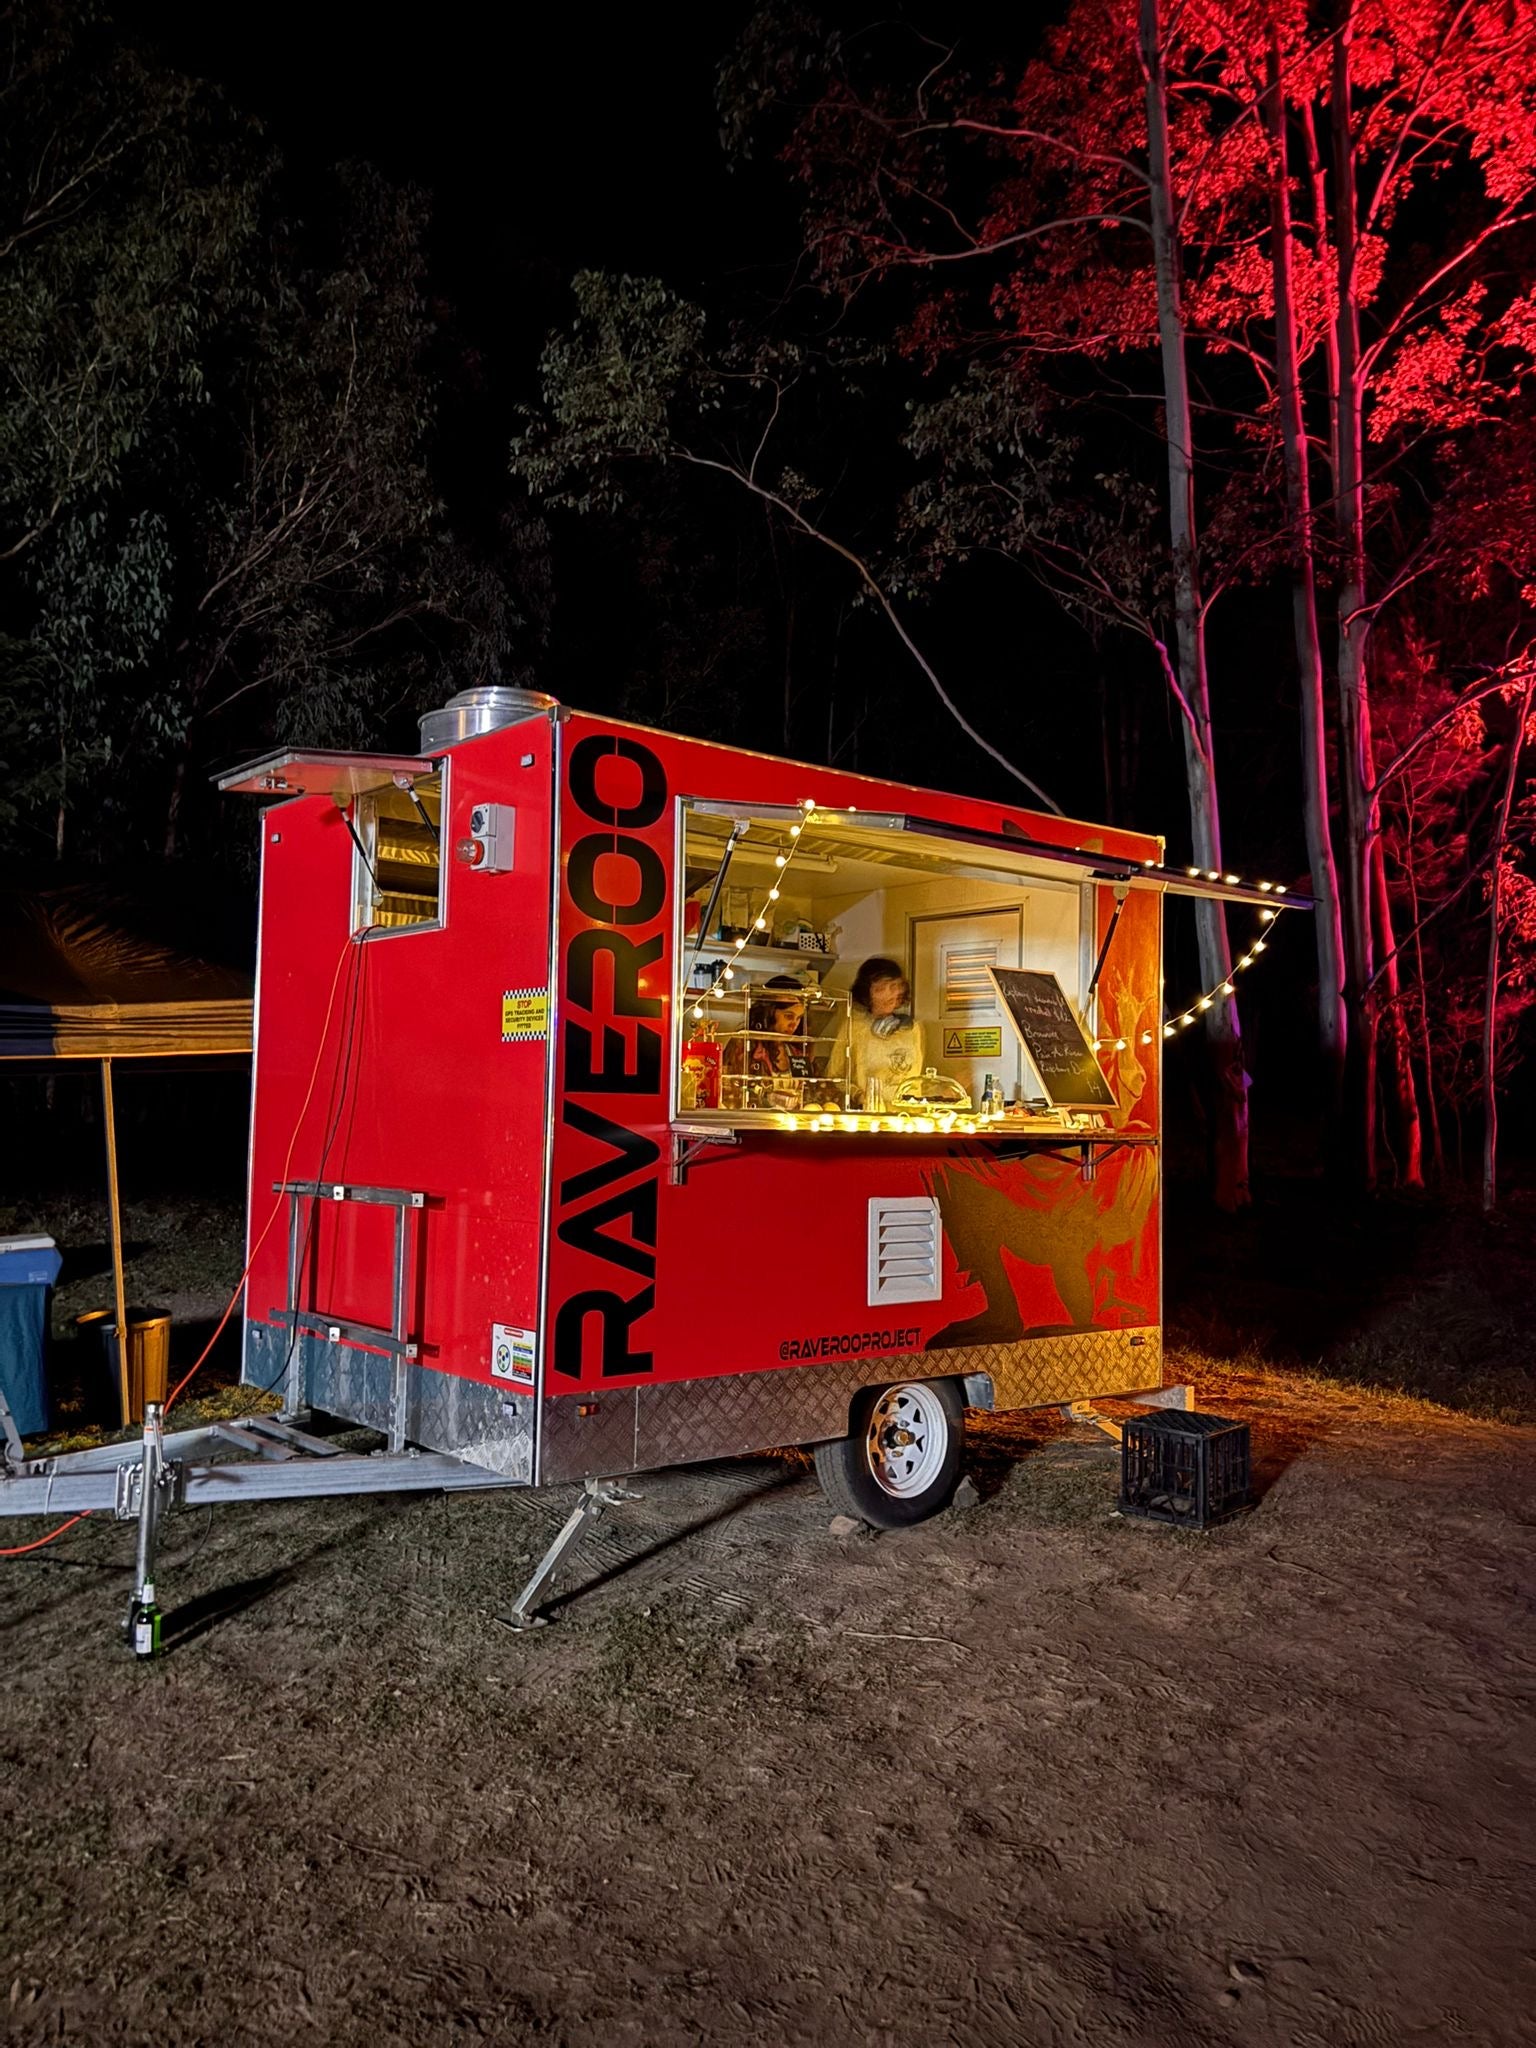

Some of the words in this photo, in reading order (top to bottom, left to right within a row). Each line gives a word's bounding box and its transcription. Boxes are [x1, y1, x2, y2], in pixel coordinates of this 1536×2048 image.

[517, 999, 532, 1009] STOP
[555, 735, 668, 1379] RAVEROO
[780, 1327, 921, 1360] @RAVEROOPROJECT
